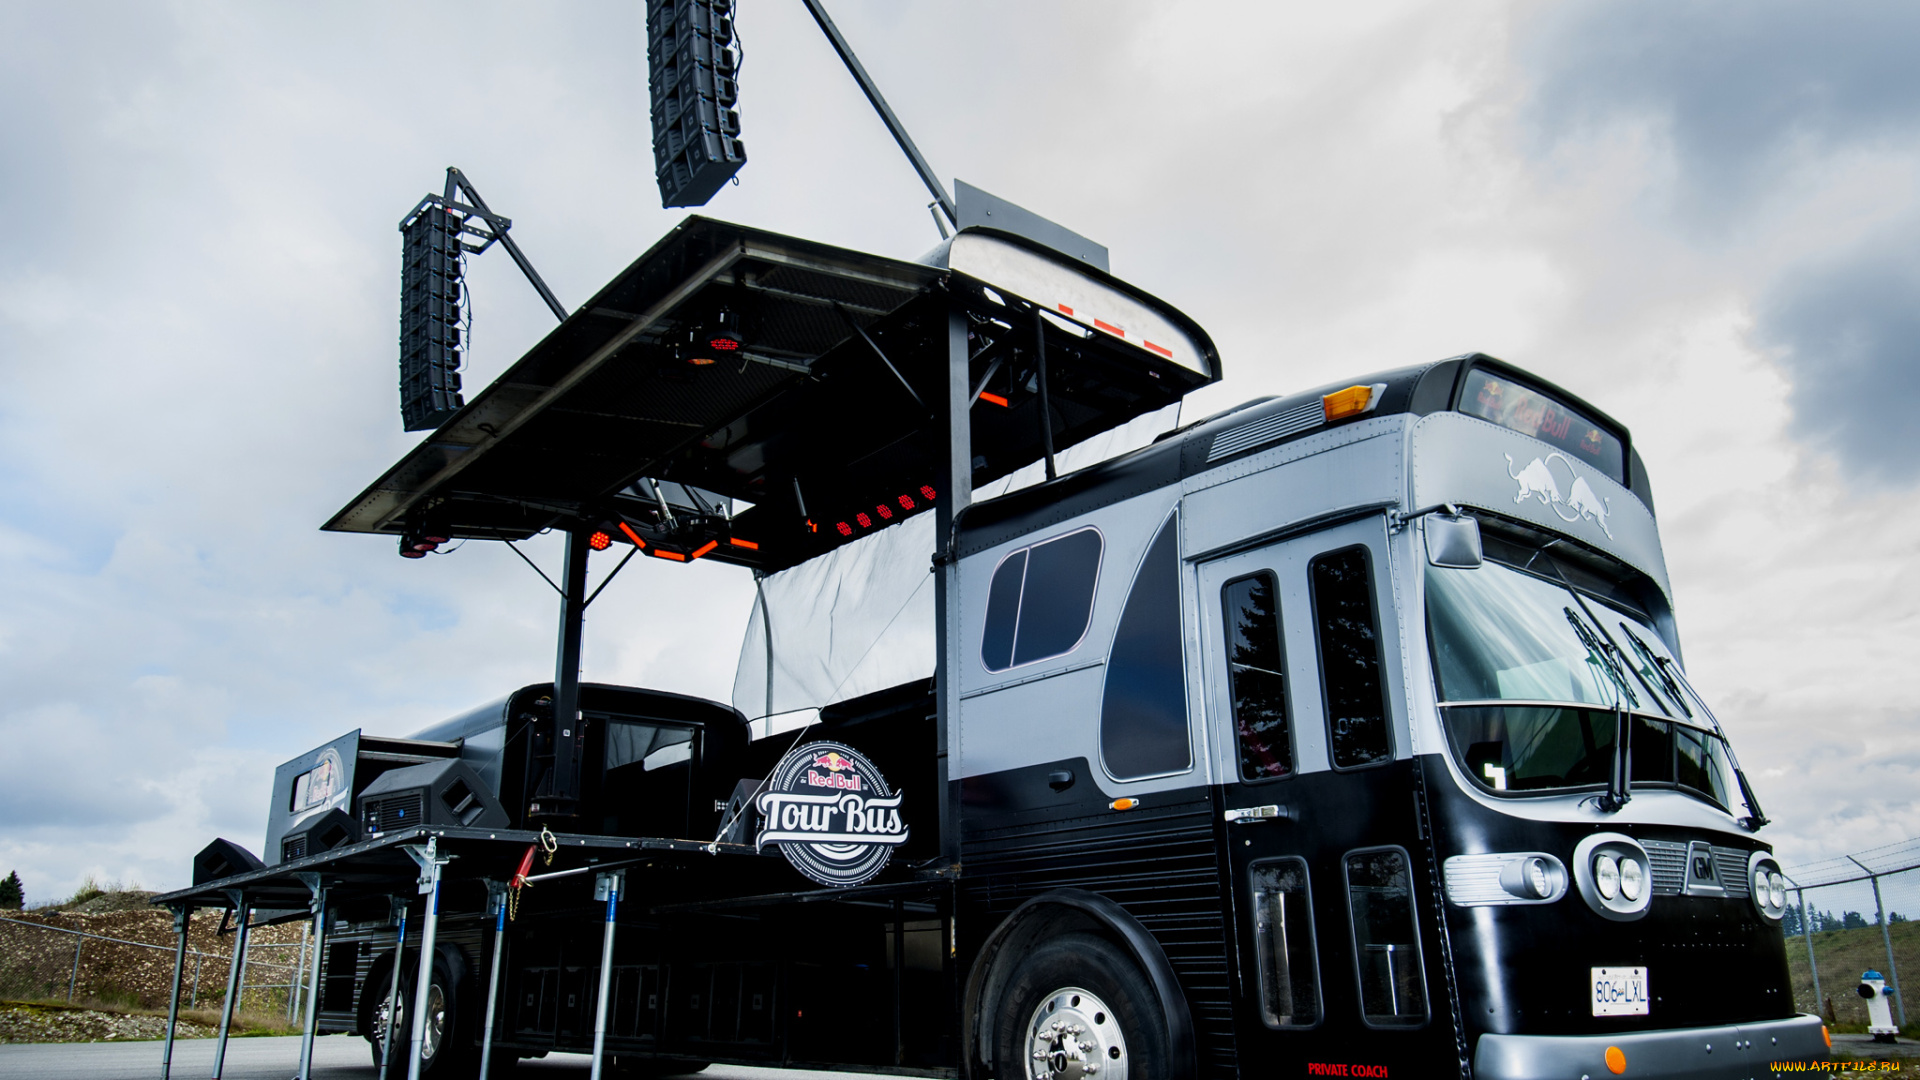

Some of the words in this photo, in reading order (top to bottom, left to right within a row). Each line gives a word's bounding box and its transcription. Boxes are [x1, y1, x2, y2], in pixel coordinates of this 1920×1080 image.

[1514, 397, 1546, 428] Red
[1542, 409, 1571, 440] Bull
[808, 771, 835, 788] Red
[836, 773, 861, 790] Bull
[761, 790, 842, 832] Tour
[839, 788, 903, 834] Bus
[1693, 856, 1714, 880] GM
[1596, 980, 1617, 1003] 806
[1625, 980, 1646, 1003] LXL
[1308, 1062, 1348, 1077] PRIVATE
[1351, 1064, 1388, 1079] COACH
